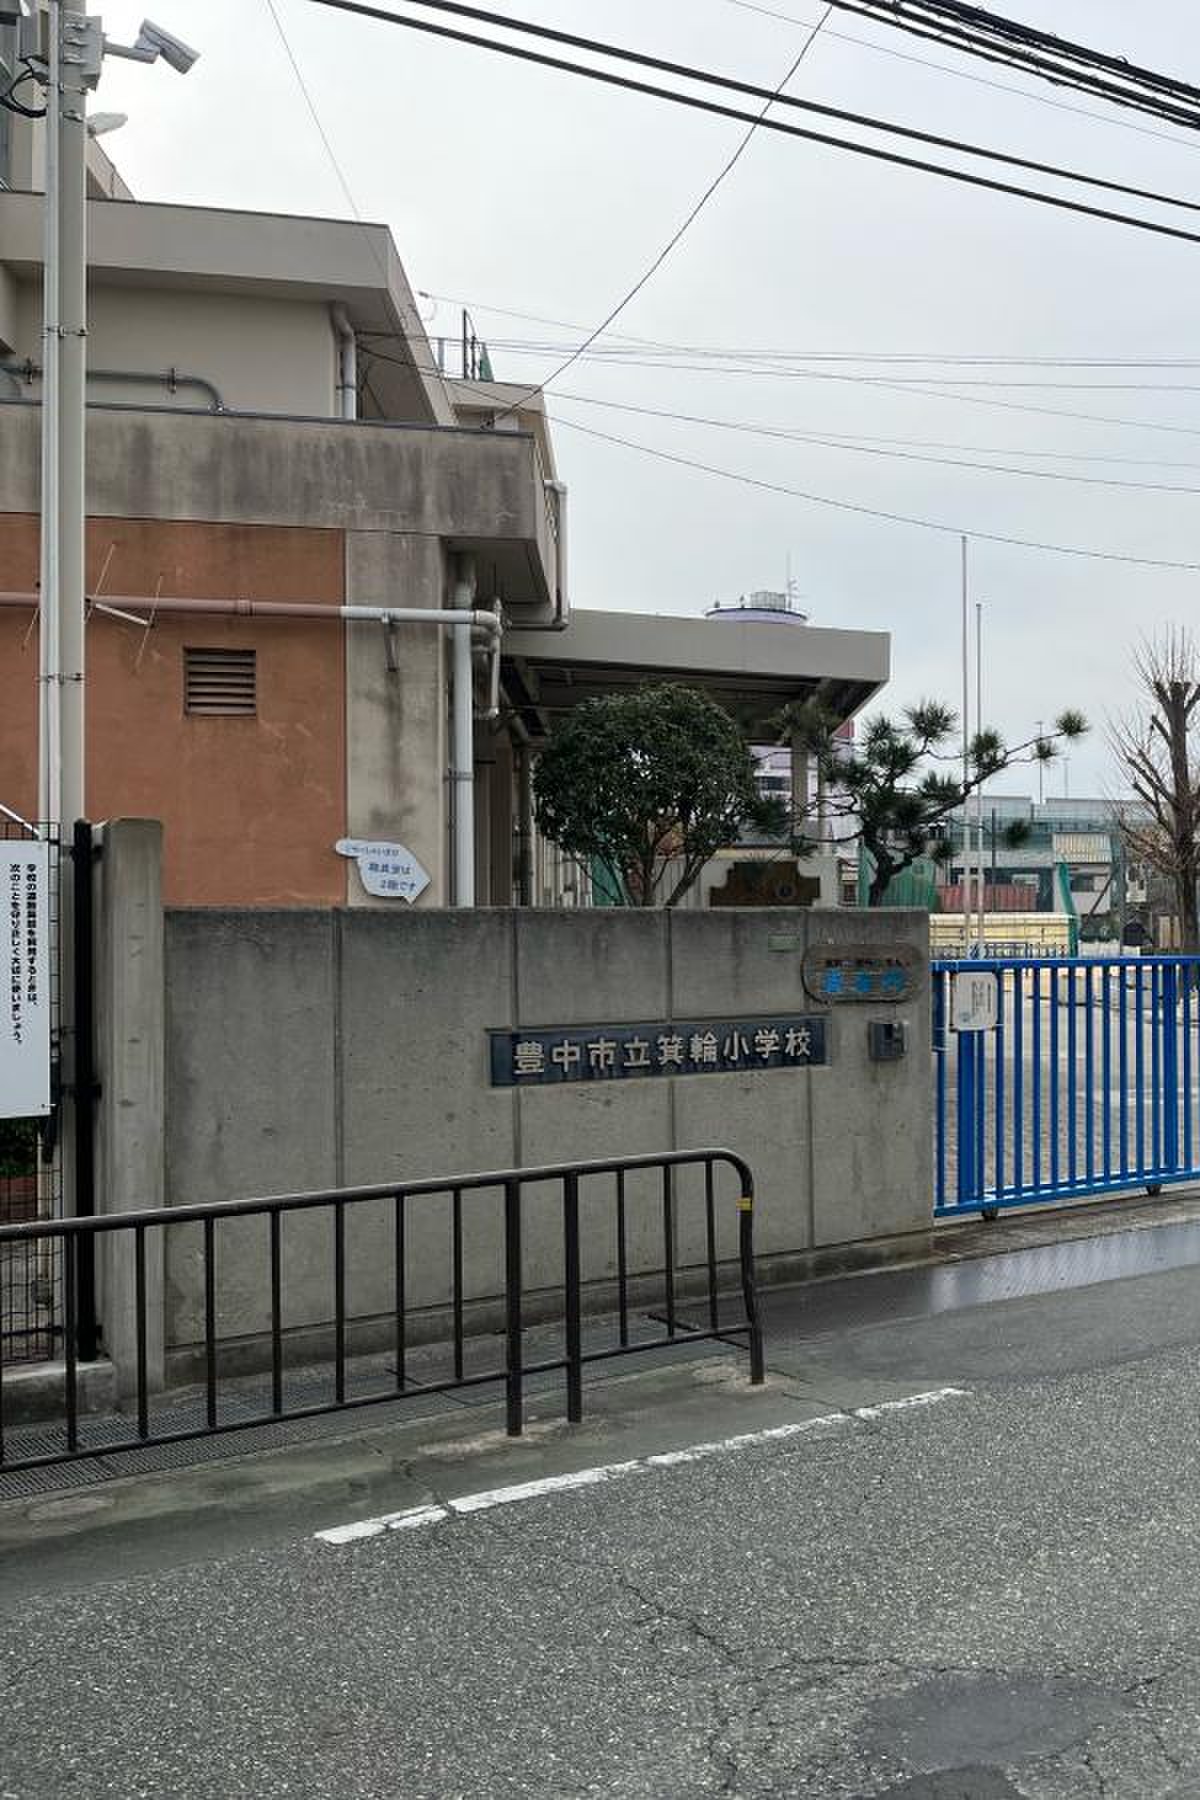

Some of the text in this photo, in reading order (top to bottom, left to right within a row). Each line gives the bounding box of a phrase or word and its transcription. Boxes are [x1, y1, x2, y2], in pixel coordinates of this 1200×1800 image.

[512, 1026, 812, 1075] 豊中市立箕輪小学校
